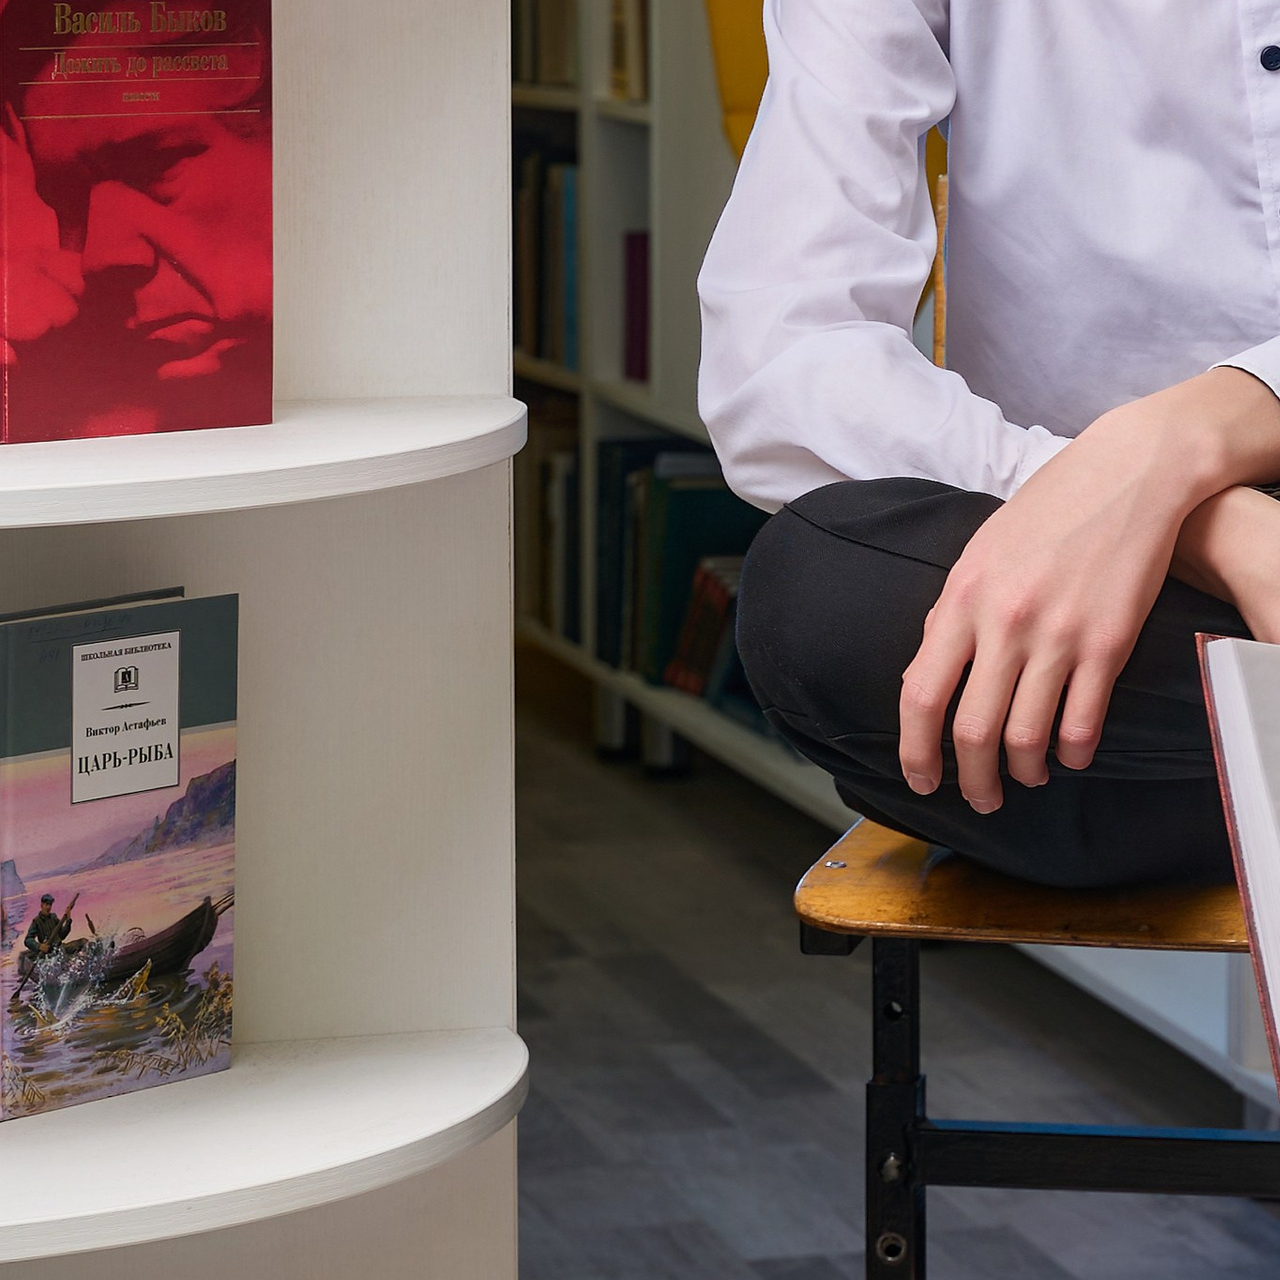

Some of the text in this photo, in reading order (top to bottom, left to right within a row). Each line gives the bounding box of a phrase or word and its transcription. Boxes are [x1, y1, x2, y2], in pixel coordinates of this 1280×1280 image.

[53, 1, 227, 35] Василь Быков
[51, 52, 229, 80] Дожить до рассвета
[80, 642, 172, 662] ШКОЛЬНАЯ БИБЛИОТЕКА
[85, 717, 167, 738] Виктор Астафьев
[78, 742, 174, 776] ЦАРЬ-РЫБА
